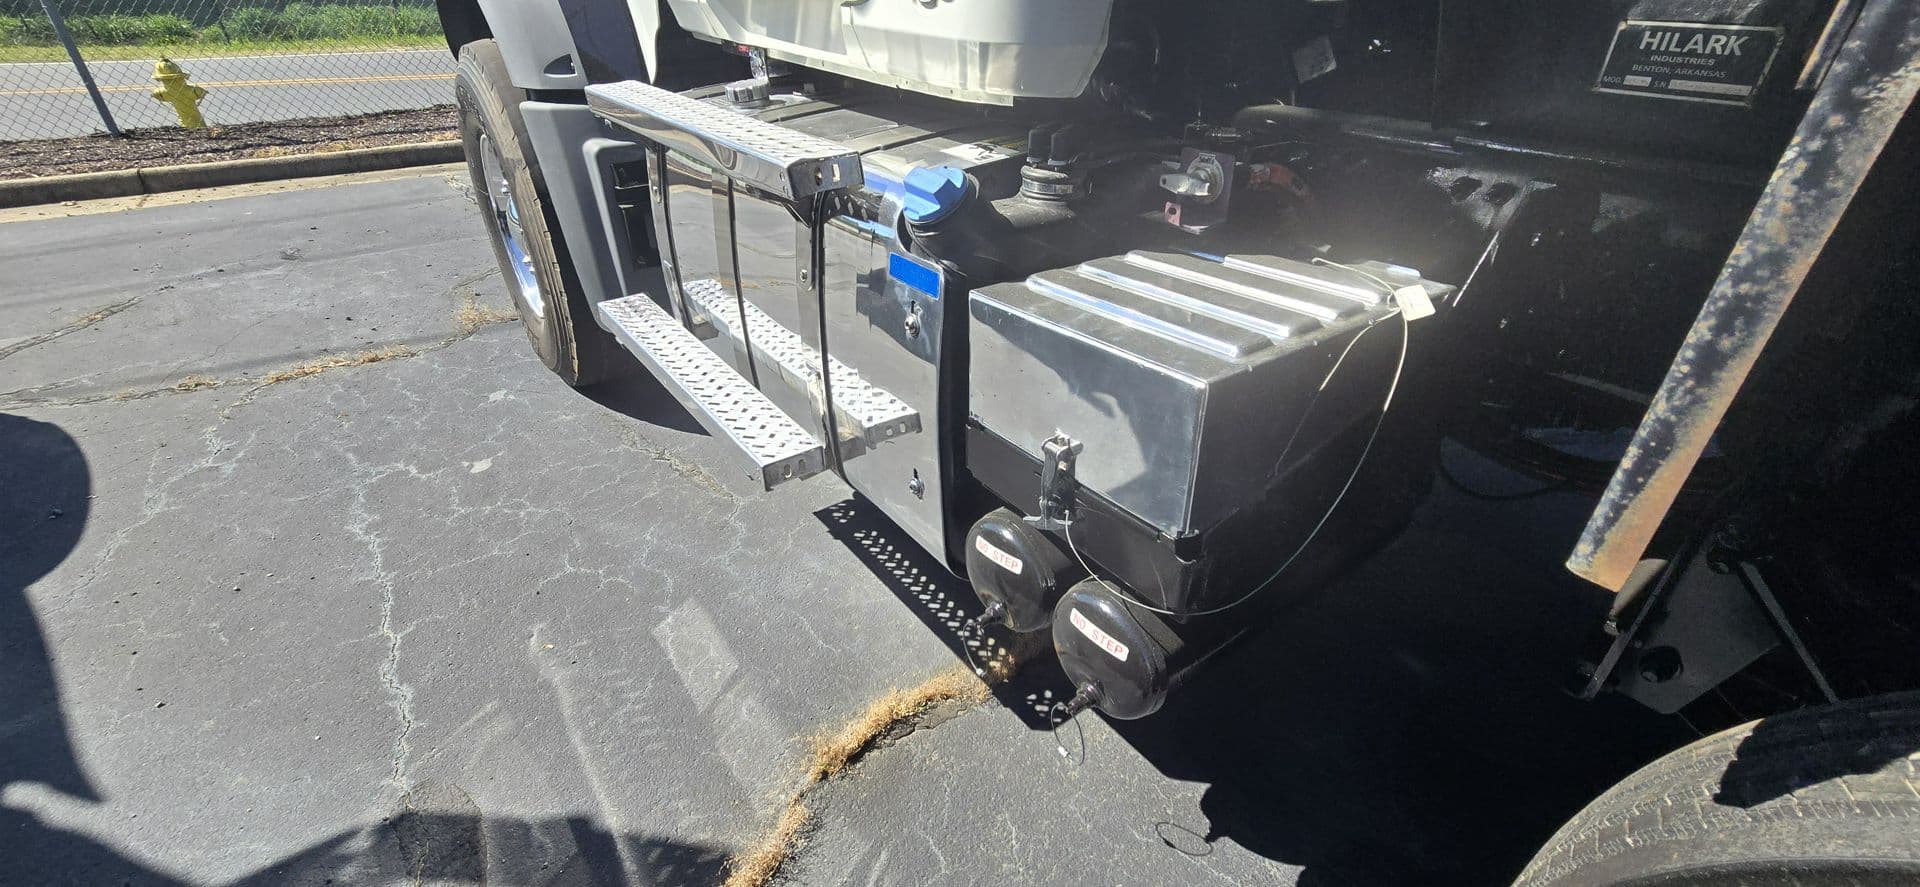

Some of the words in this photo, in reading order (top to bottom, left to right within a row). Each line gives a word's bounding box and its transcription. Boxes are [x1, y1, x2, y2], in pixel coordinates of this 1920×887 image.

[1639, 30, 1750, 56] HILARK
[1632, 64, 1671, 75] BENTON,
[1675, 68, 1727, 79] ARKANSAS
[1650, 55, 1716, 66] INDUSTRIES
[977, 539, 989, 553] NO
[992, 550, 1018, 569] STEP
[1073, 613, 1086, 630] NO
[1092, 629, 1123, 654] STEP
